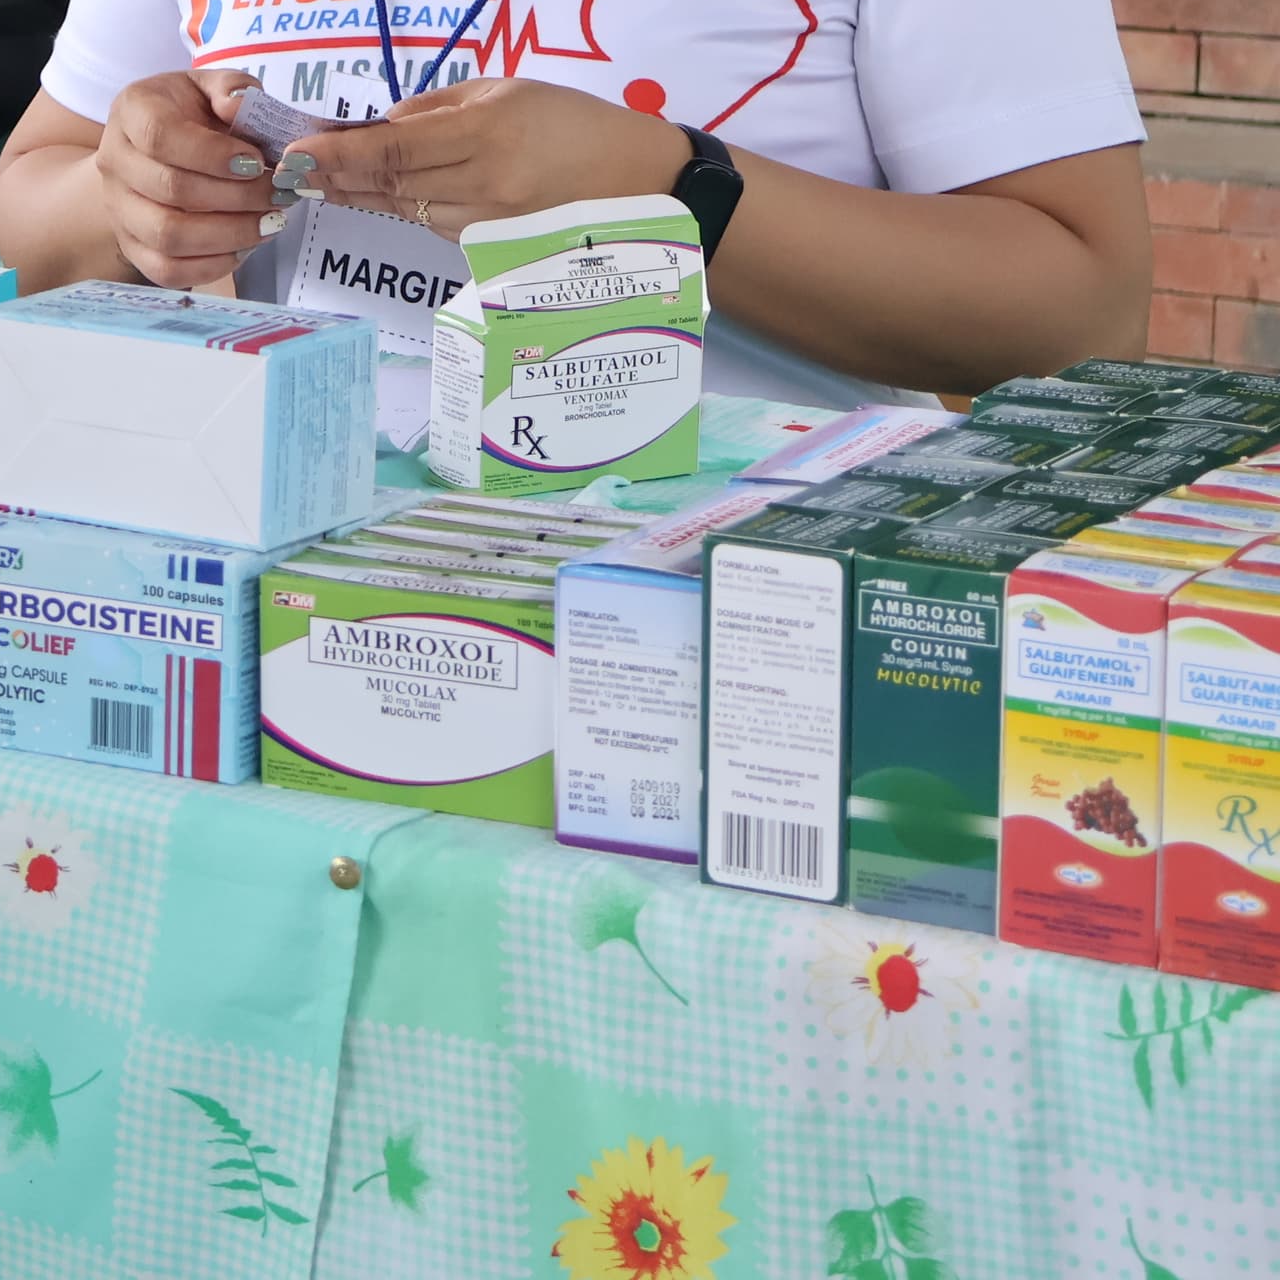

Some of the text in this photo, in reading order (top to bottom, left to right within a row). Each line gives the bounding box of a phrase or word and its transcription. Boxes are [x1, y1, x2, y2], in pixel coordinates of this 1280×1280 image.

[246, 5, 483, 36] A RURAL BANK
[568, 266, 618, 277] VENTOMAX
[554, 275, 634, 290] SULFATE
[525, 281, 661, 305] SALBUTAMOL
[526, 350, 667, 381] SALBUTAMOL
[555, 370, 639, 391] SULFATE
[563, 389, 628, 406] VENTOMAX
[585, 404, 594, 413] mg
[595, 402, 613, 410] Tablet
[564, 408, 625, 422] BRONCHODILATOR
[142, 584, 224, 606] 100 capsules
[966, 591, 998, 604] 60 mL
[717, 609, 816, 629] DOSAGE AND MODE OF
[872, 598, 986, 626] AMBROXOL
[870, 613, 986, 640] HYDROCHLORIDE
[323, 625, 504, 665] AMBROXOL
[891, 638, 967, 660] COUXIN
[324, 646, 502, 682] HYDROCHLORIDE
[569, 656, 616, 669] DOSAGE AND
[882, 653, 973, 675] 30 mL Syrup
[1025, 646, 1143, 673] SALBUTAMOL+
[11, 664, 68, 686] CAPSULE
[877, 668, 982, 695] MUCOLYTIC
[1029, 663, 1135, 688] GUAIFENESIN
[366, 677, 457, 702] MUCOLAX
[1054, 688, 1112, 706] ASMAIR
[381, 694, 441, 710] 30 mg Tablet
[381, 706, 441, 722] MUCOLYTIC
[1216, 712, 1276, 730] ASMAIR
[587, 726, 610, 736] STORE
[622, 730, 678, 746] TEMPERATURES
[1063, 728, 1099, 741] SYRUP
[610, 740, 651, 752] EXCEEDING
[1227, 754, 1264, 767] SYRUP
